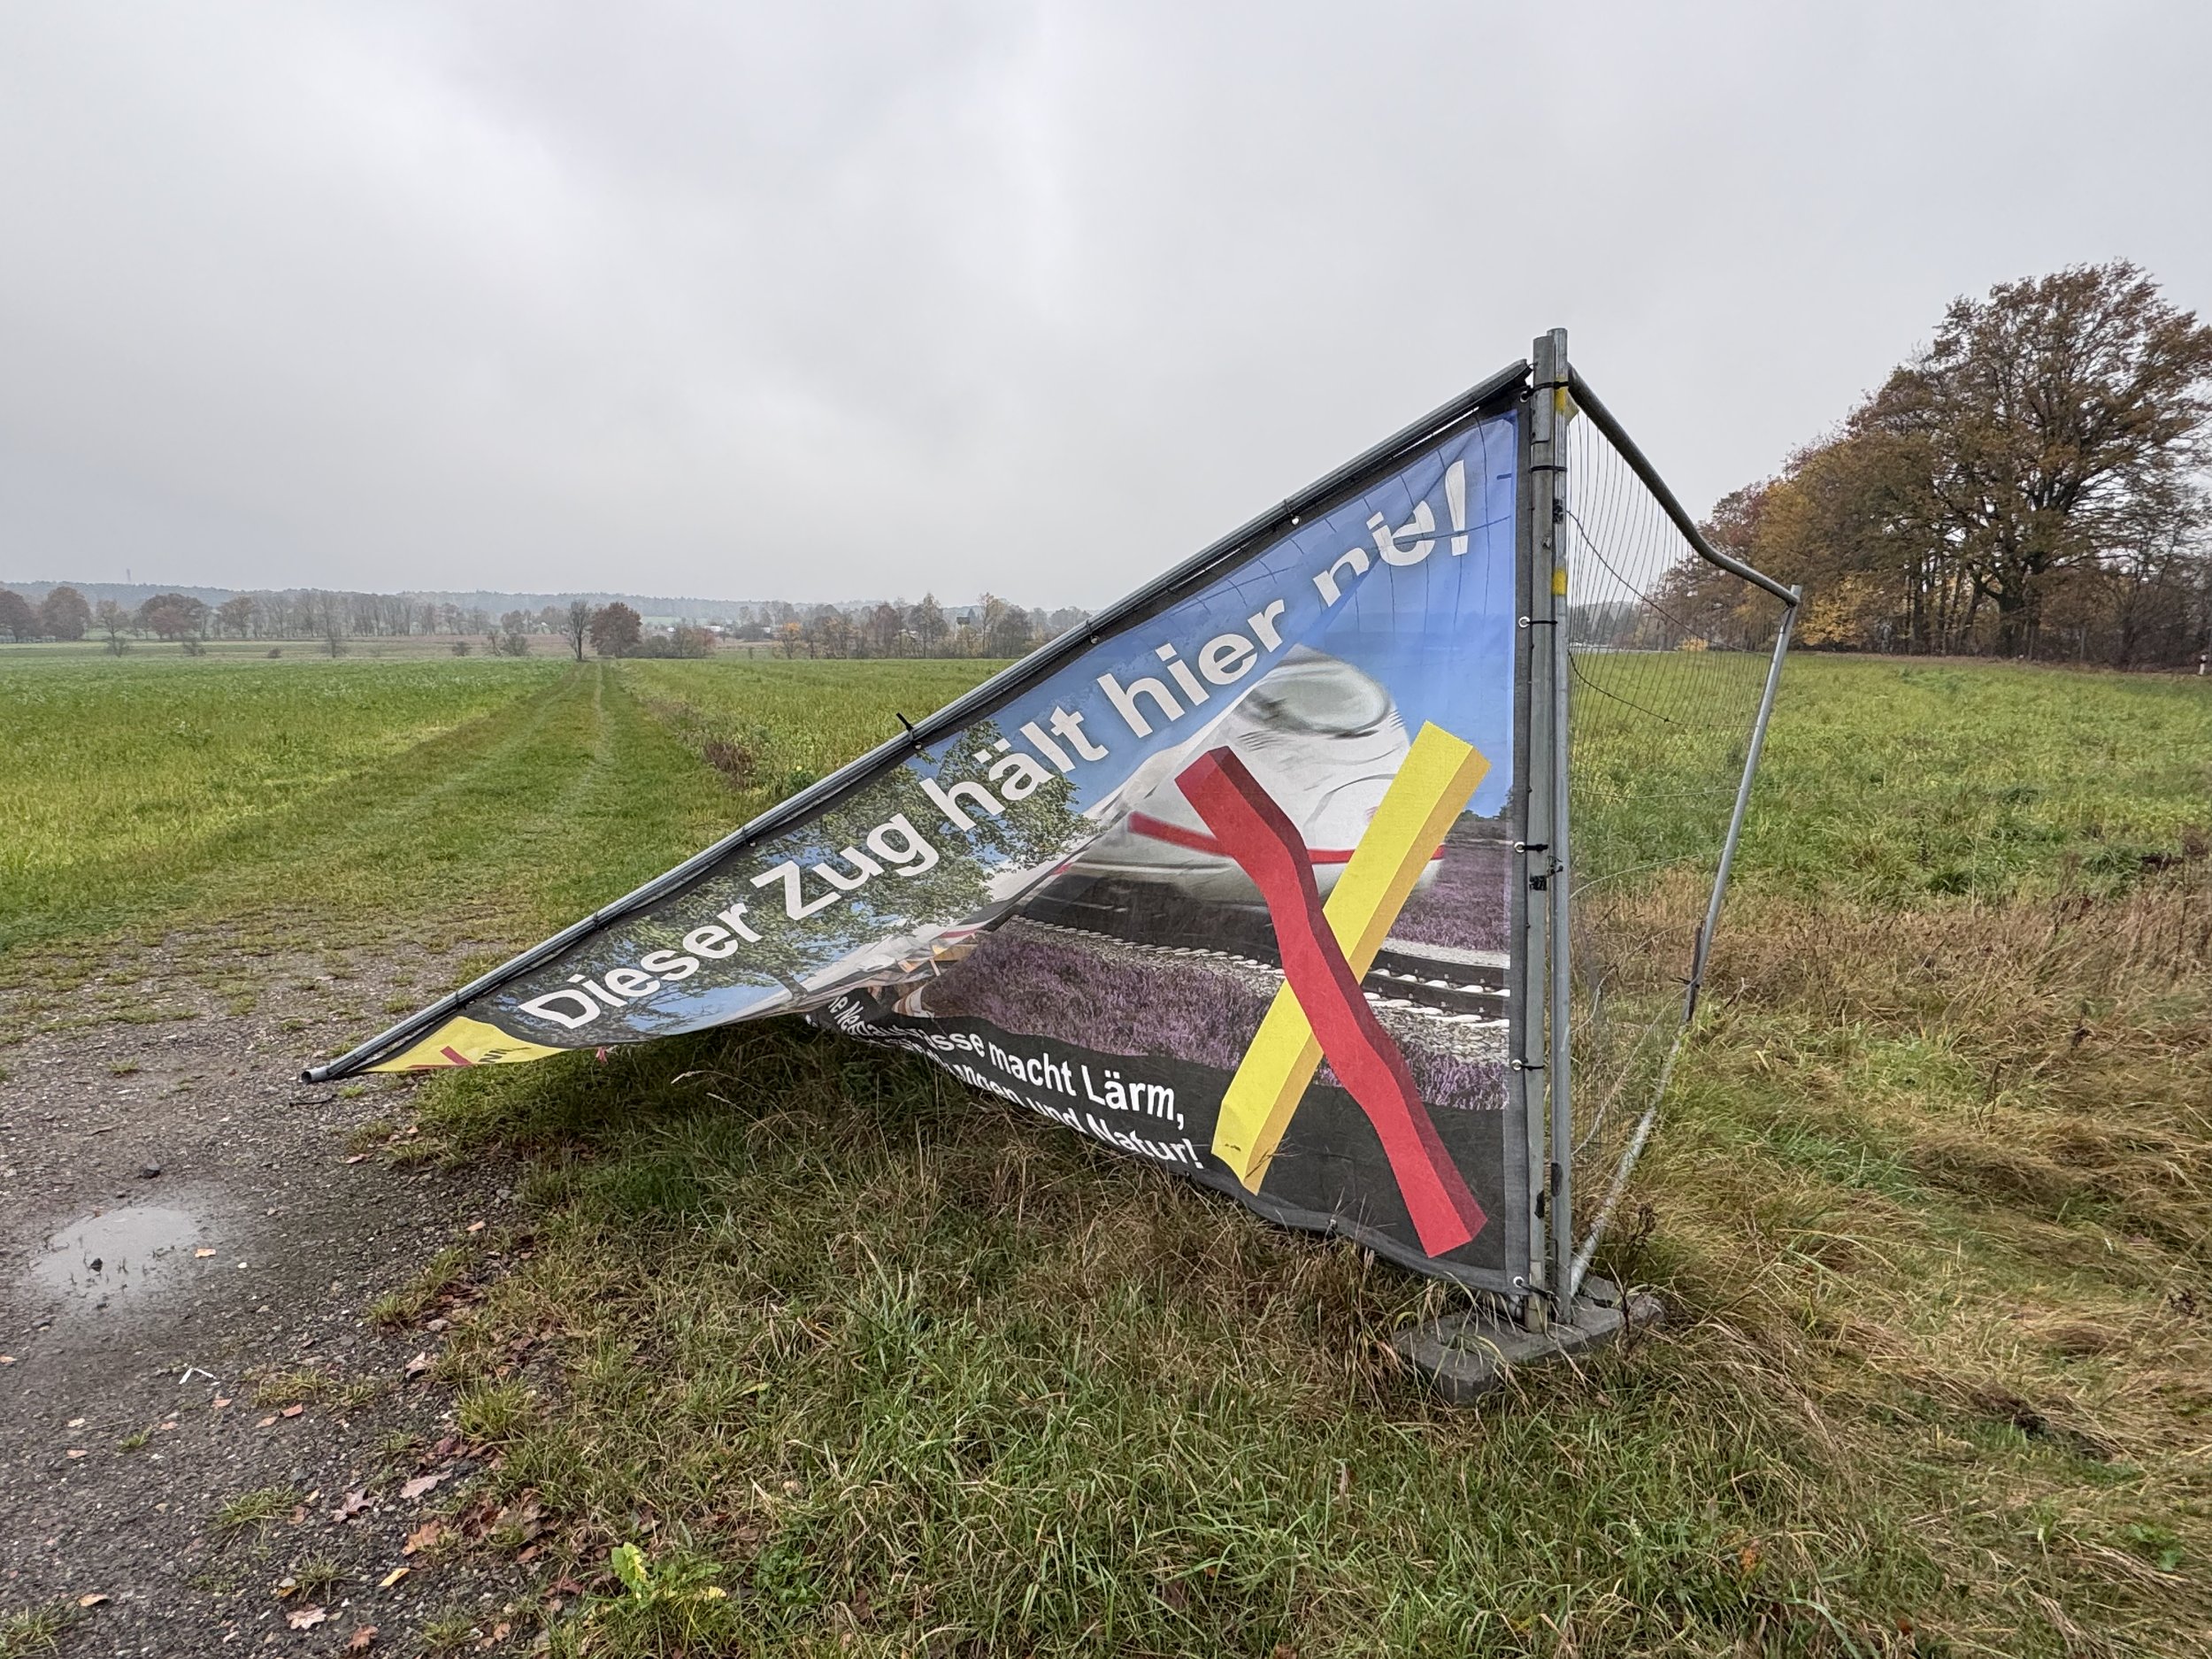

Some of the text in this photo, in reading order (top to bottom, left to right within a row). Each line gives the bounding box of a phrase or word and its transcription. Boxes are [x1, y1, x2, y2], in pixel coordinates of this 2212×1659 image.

[518, 903, 763, 1029] Dieser
[750, 813, 939, 921] Zug
[919, 705, 1109, 832] hält
[1096, 599, 1286, 738] hier
[988, 1041, 1078, 1097] macht
[1081, 1064, 1184, 1131] Lärm,
[1086, 1113, 1204, 1169] Natur!
